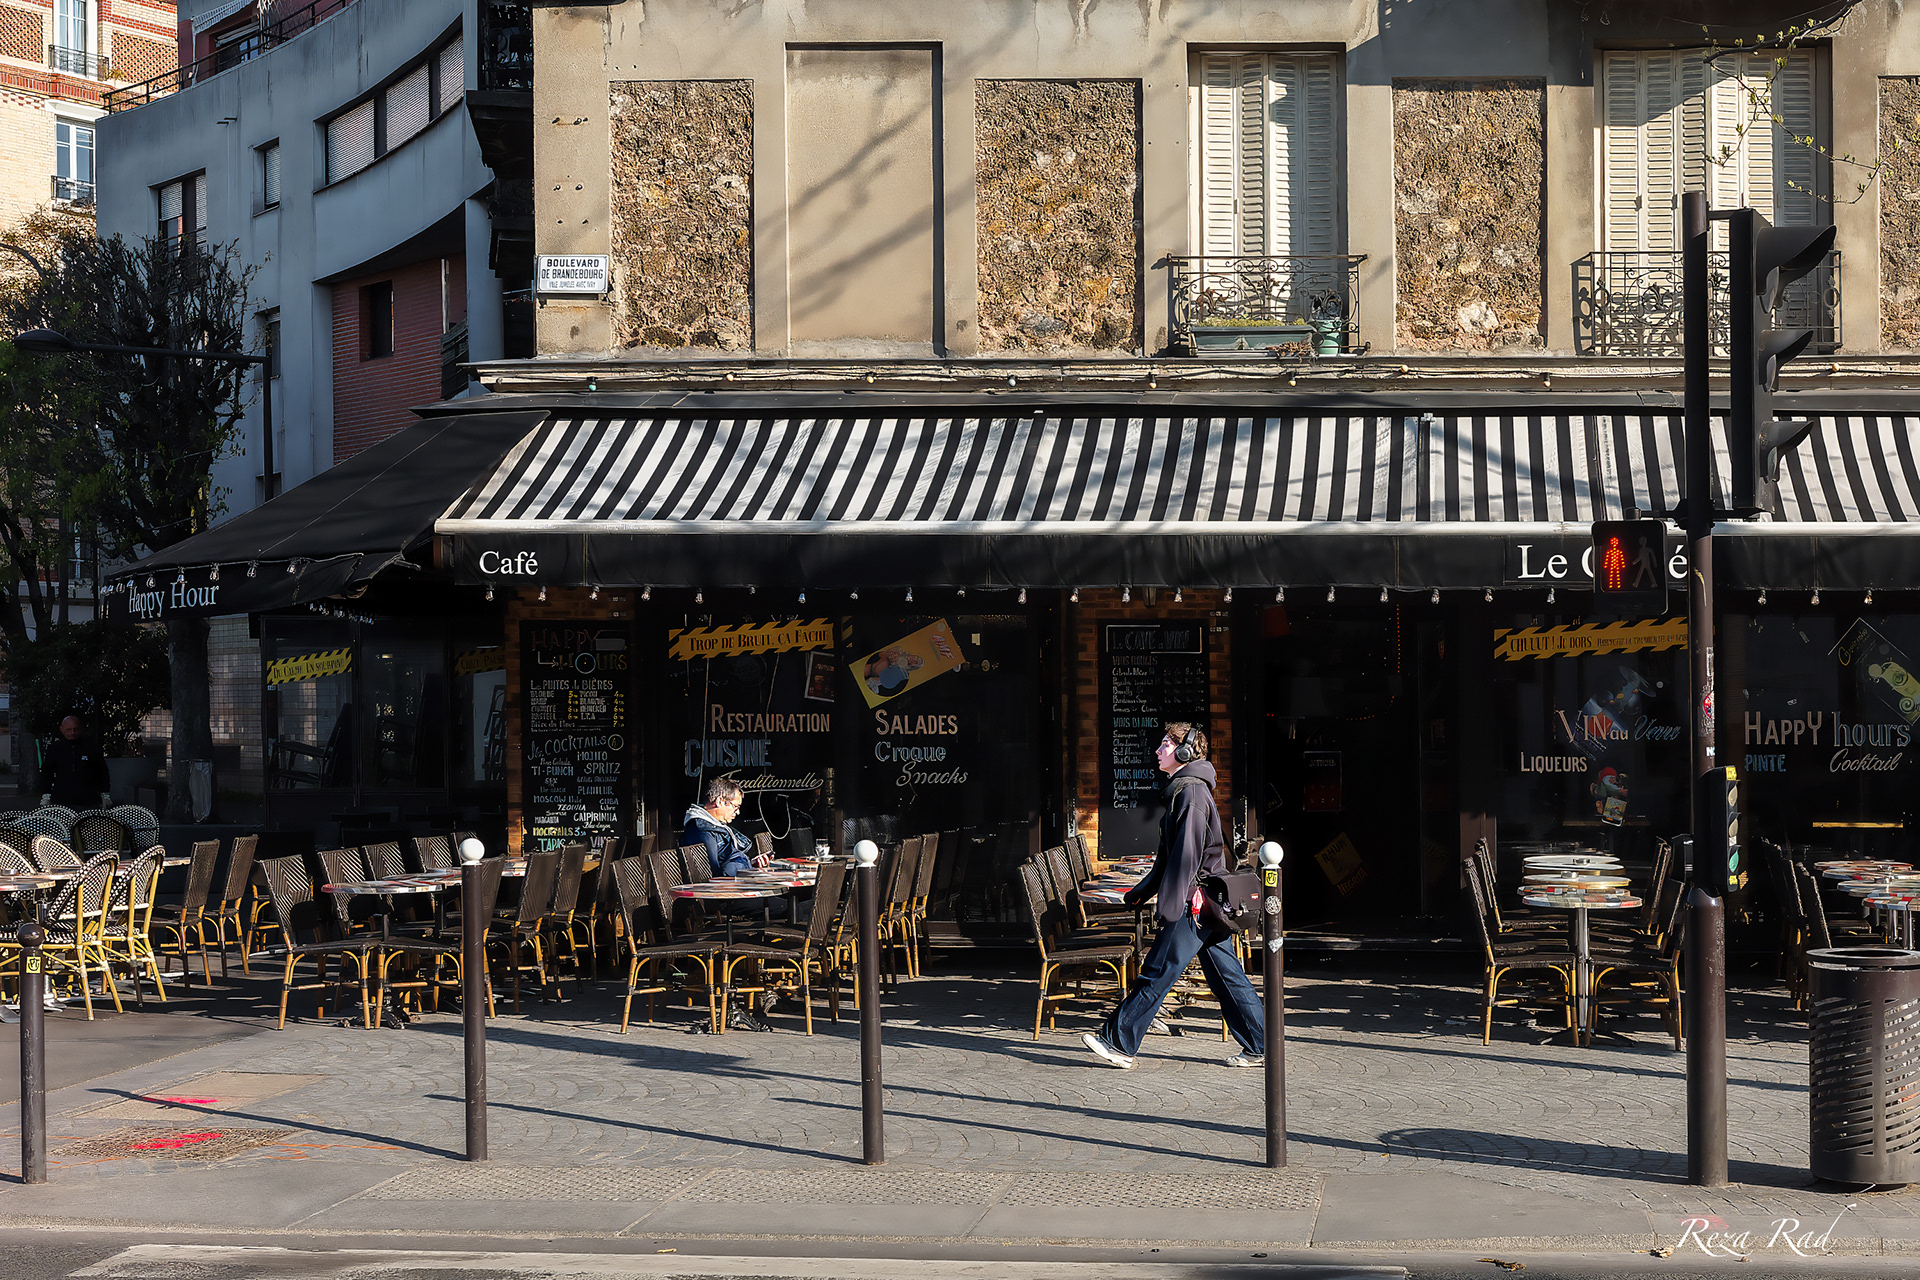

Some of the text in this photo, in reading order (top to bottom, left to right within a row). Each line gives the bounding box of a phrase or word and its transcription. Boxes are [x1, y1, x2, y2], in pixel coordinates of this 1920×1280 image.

[541, 269, 604, 279] DE BRANDEBOURG
[547, 259, 600, 268] BOULEVARD
[479, 551, 539, 576] Café
[1517, 545, 1568, 579] Le
[128, 581, 219, 619] Happy Hour
[530, 628, 601, 653] HAPPY
[687, 637, 719, 651] TROP
[1569, 636, 1592, 648] DORS
[582, 677, 614, 690] BIÈRES
[711, 703, 831, 733] RESTAURATION
[874, 708, 959, 736] SALADES
[1554, 709, 1608, 744] VIN
[1609, 728, 1630, 742] au
[1744, 711, 1913, 747] HAPPY hours
[545, 735, 607, 756] COCKTAILS
[577, 751, 608, 761] MOJITO
[874, 741, 948, 763] Croque
[584, 762, 621, 775] SPRITZ
[684, 738, 773, 778] CUISINE
[1520, 751, 1588, 774] LIQUEURS
[1744, 753, 1787, 773] PINTE
[1829, 747, 1904, 774] Cocktail
[719, 768, 825, 794] Traditionnelle
[896, 761, 969, 788] Snacks
[533, 795, 566, 803] MOSCOW
